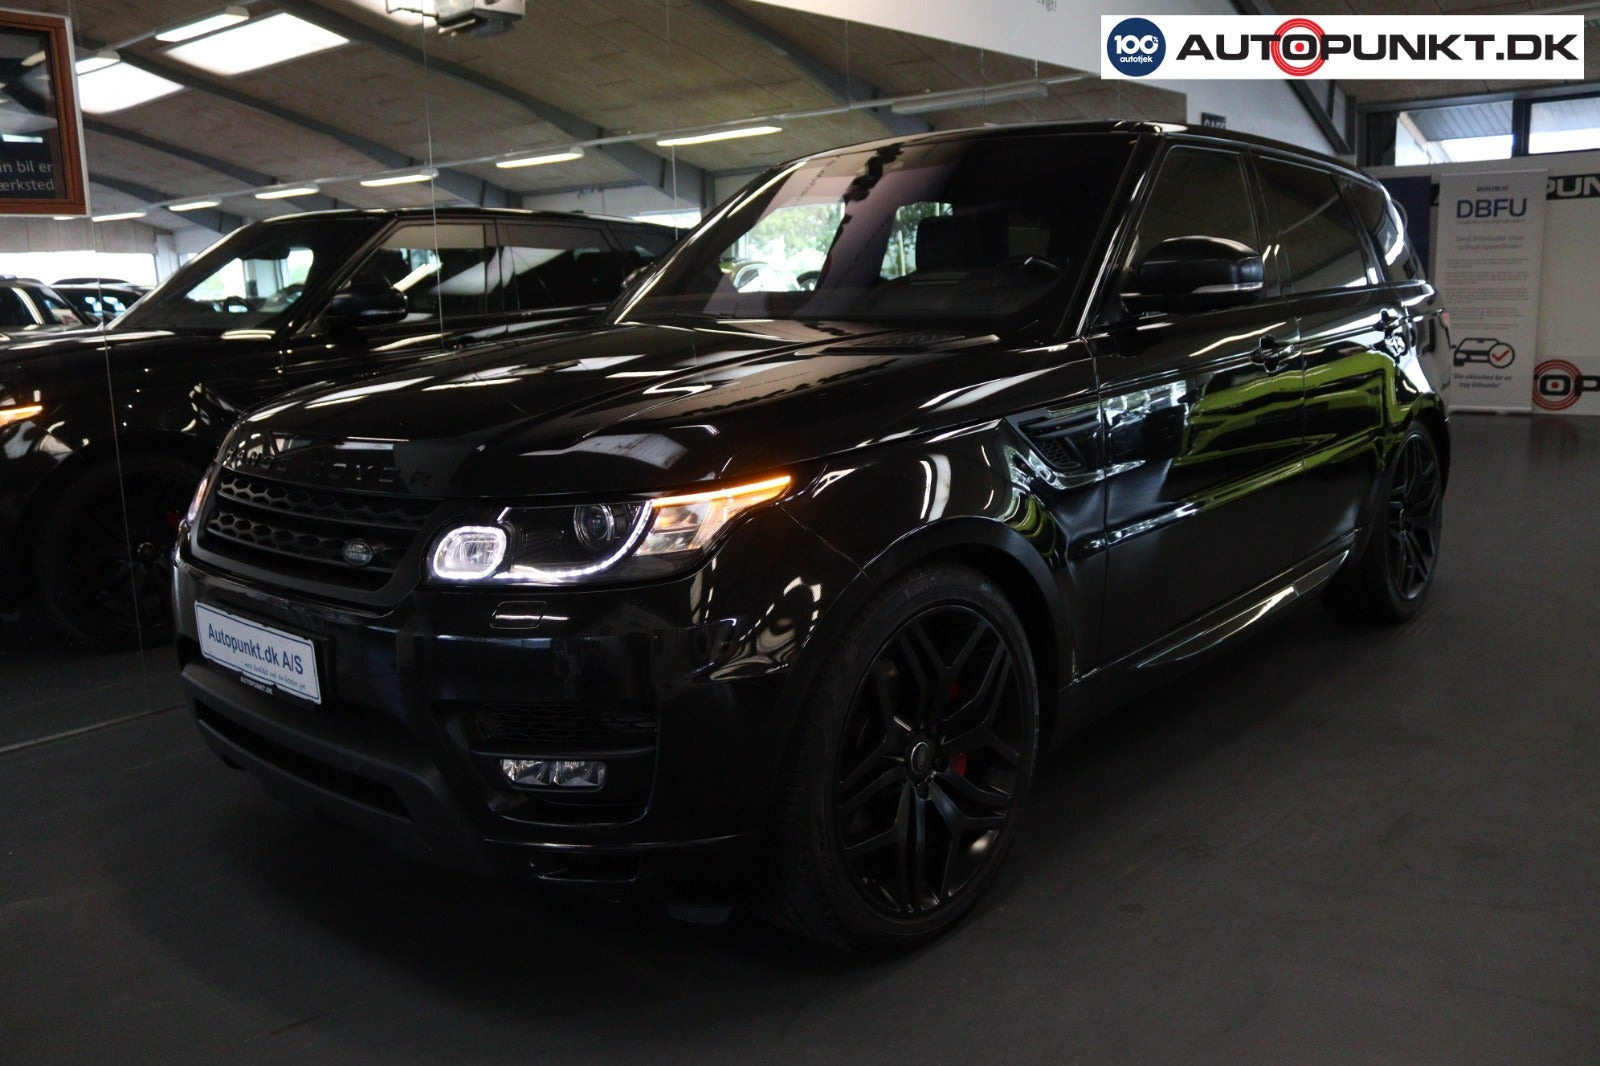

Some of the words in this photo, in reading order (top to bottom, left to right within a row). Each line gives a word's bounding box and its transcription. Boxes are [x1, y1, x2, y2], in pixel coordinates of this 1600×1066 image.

[16, 160, 35, 173] bil
[39, 163, 52, 173] er
[1456, 198, 1527, 218] DBFU
[208, 623, 279, 666] Autopunkt.dk
[282, 651, 304, 675] A/S
